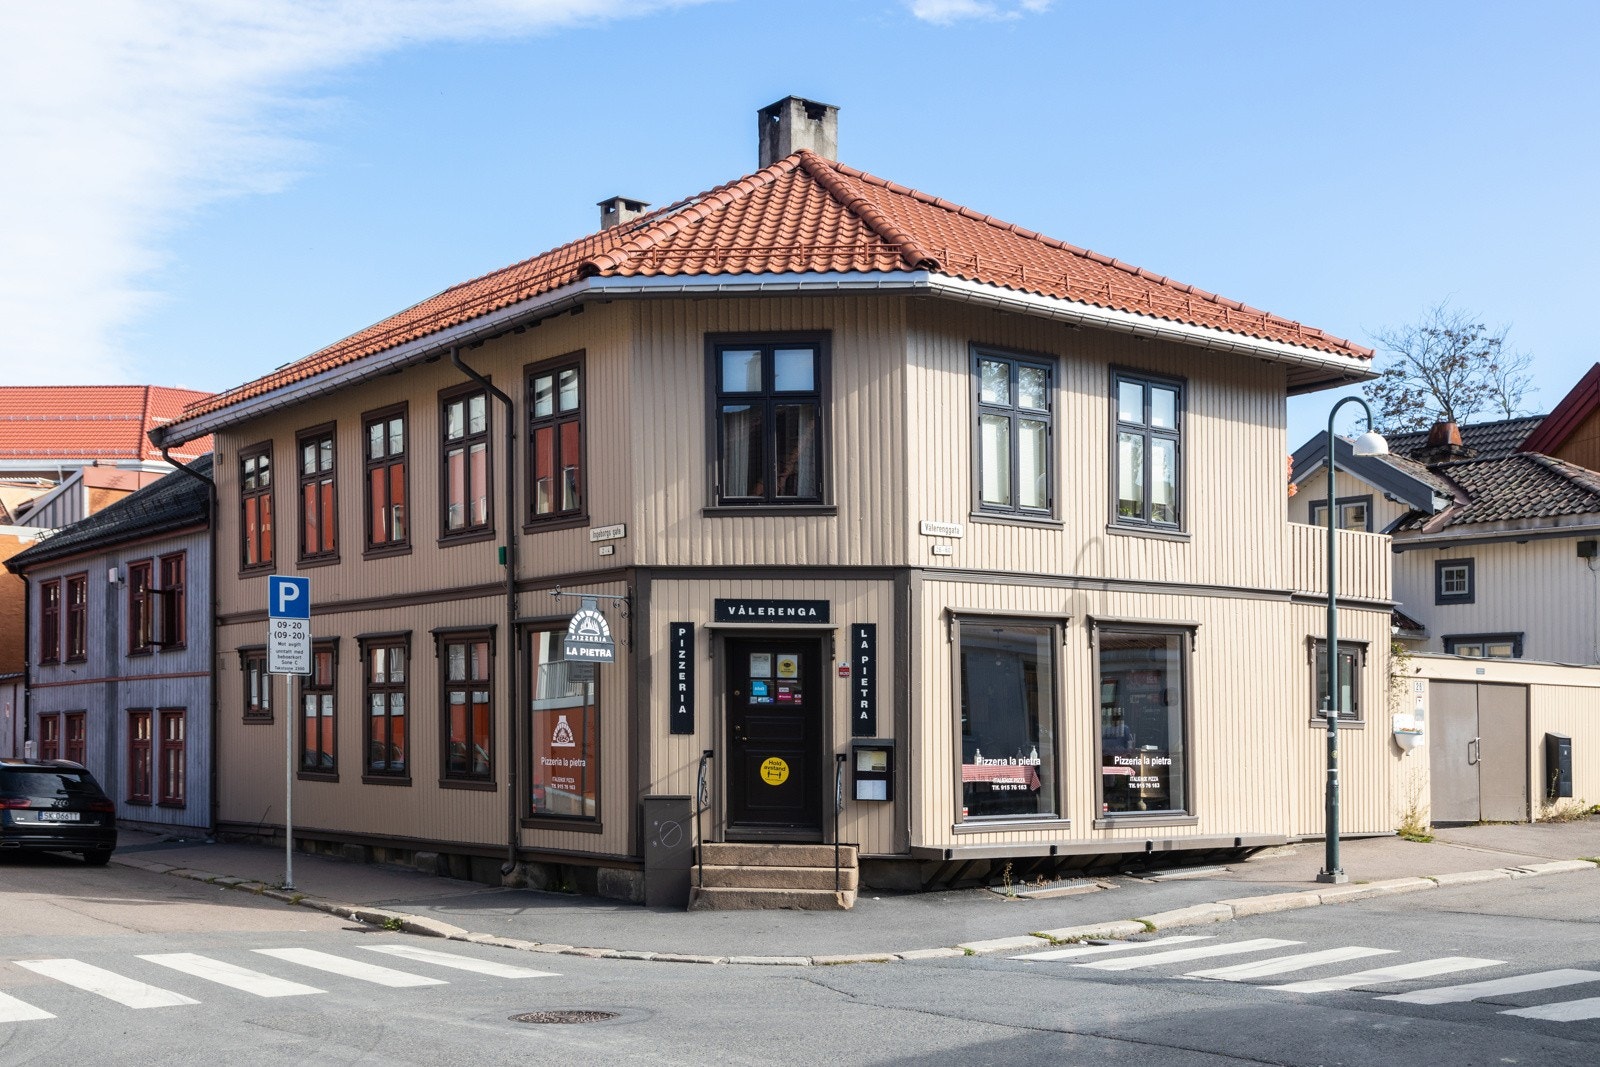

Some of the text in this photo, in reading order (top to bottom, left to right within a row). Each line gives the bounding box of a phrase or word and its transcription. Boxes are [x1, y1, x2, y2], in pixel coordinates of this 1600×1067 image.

[592, 527, 621, 538] Ingeborgs gate
[279, 582, 300, 612] P
[728, 604, 817, 616] VÅLERENGA
[566, 647, 612, 658] LA PIETRA
[678, 628, 687, 714] PIZZERIA
[860, 630, 869, 720] LA PIETRA
[540, 757, 586, 768] Pizzeria la pietra
[976, 756, 1041, 766] Pizzeria la pietra
[1114, 756, 1172, 766] Pizzeria la pietra
[44, 812, 53, 820] SK
